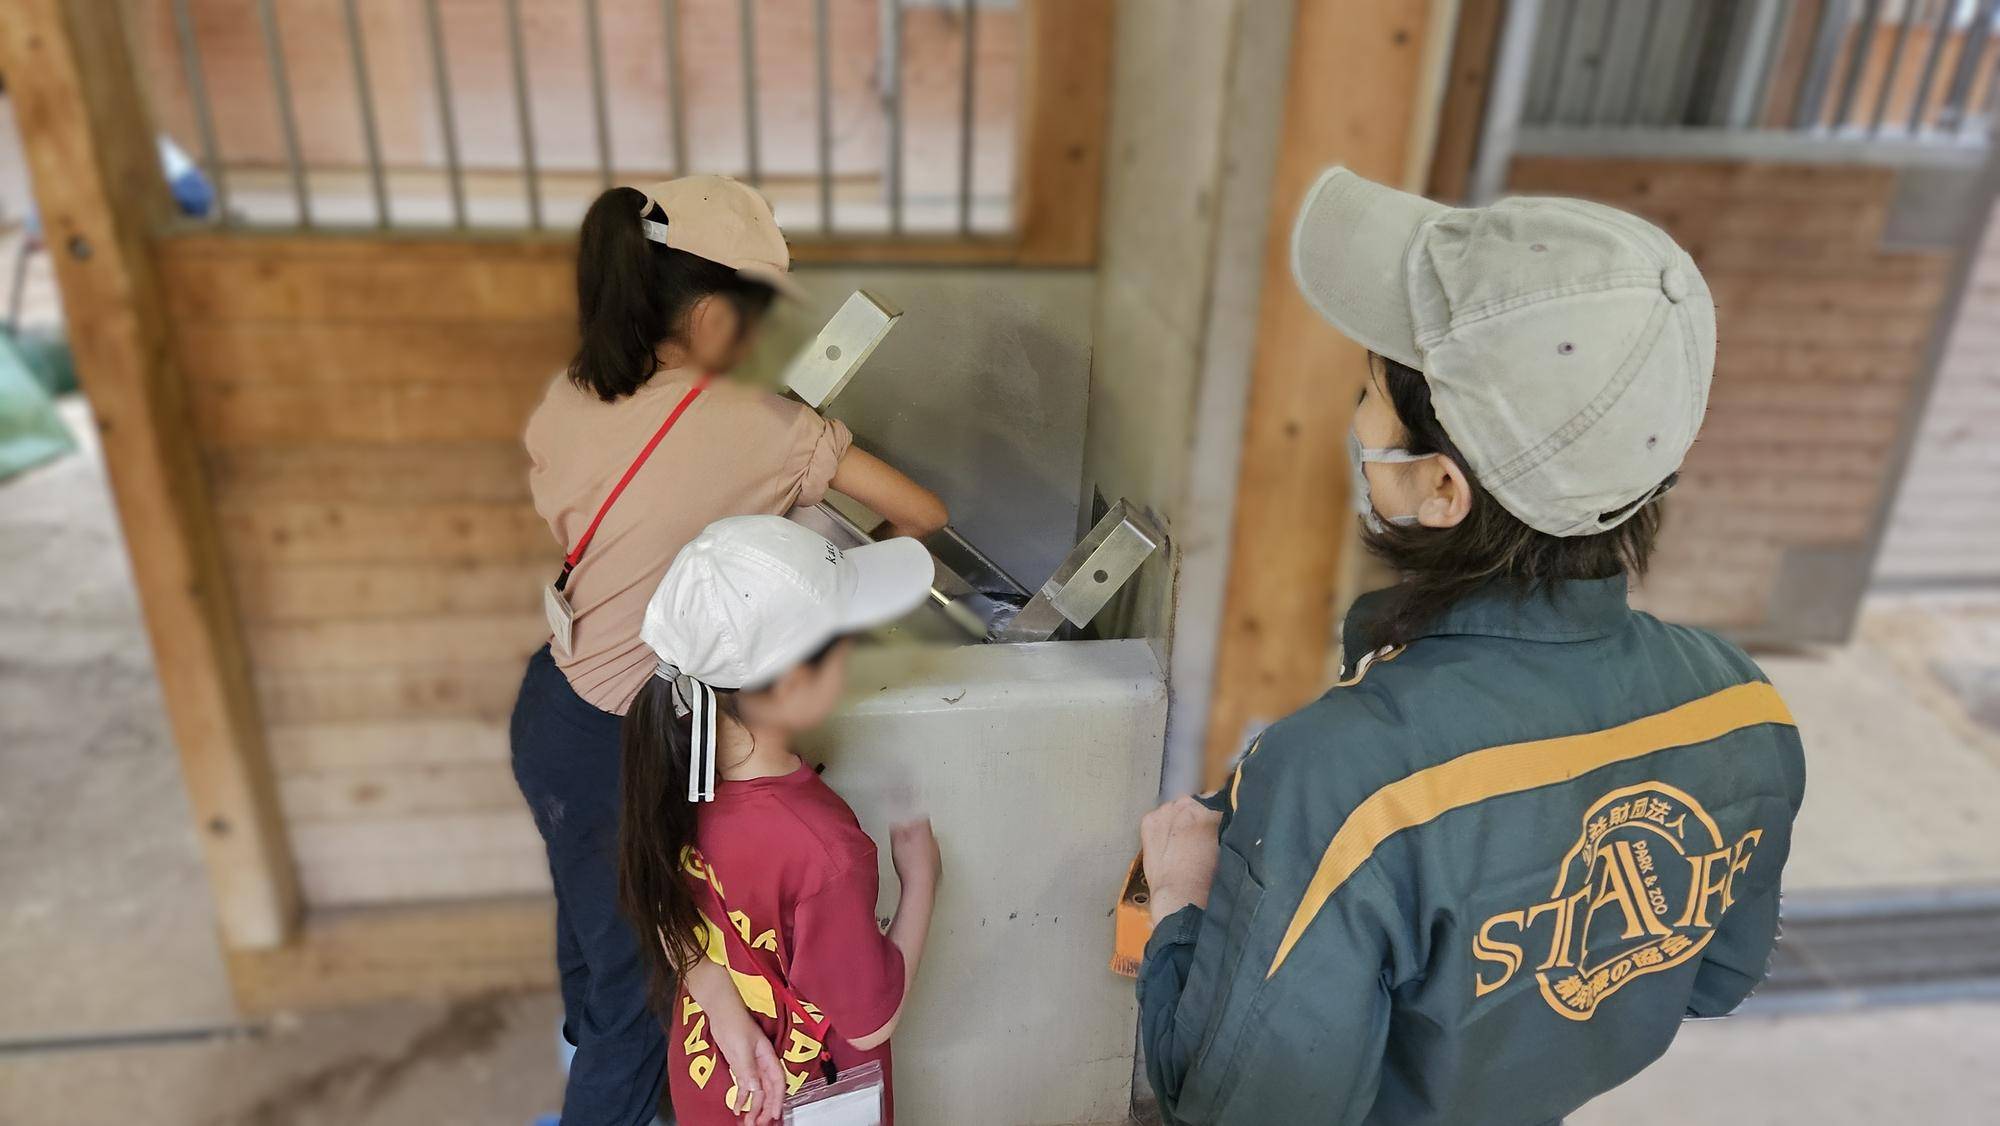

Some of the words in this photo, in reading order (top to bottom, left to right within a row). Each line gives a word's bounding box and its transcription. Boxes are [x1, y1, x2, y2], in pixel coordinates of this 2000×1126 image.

[1632, 840, 1654, 875] PARK
[1645, 875, 1658, 887] &
[1473, 829, 1763, 997] STAFF
[1649, 886, 1669, 916] ZOO
